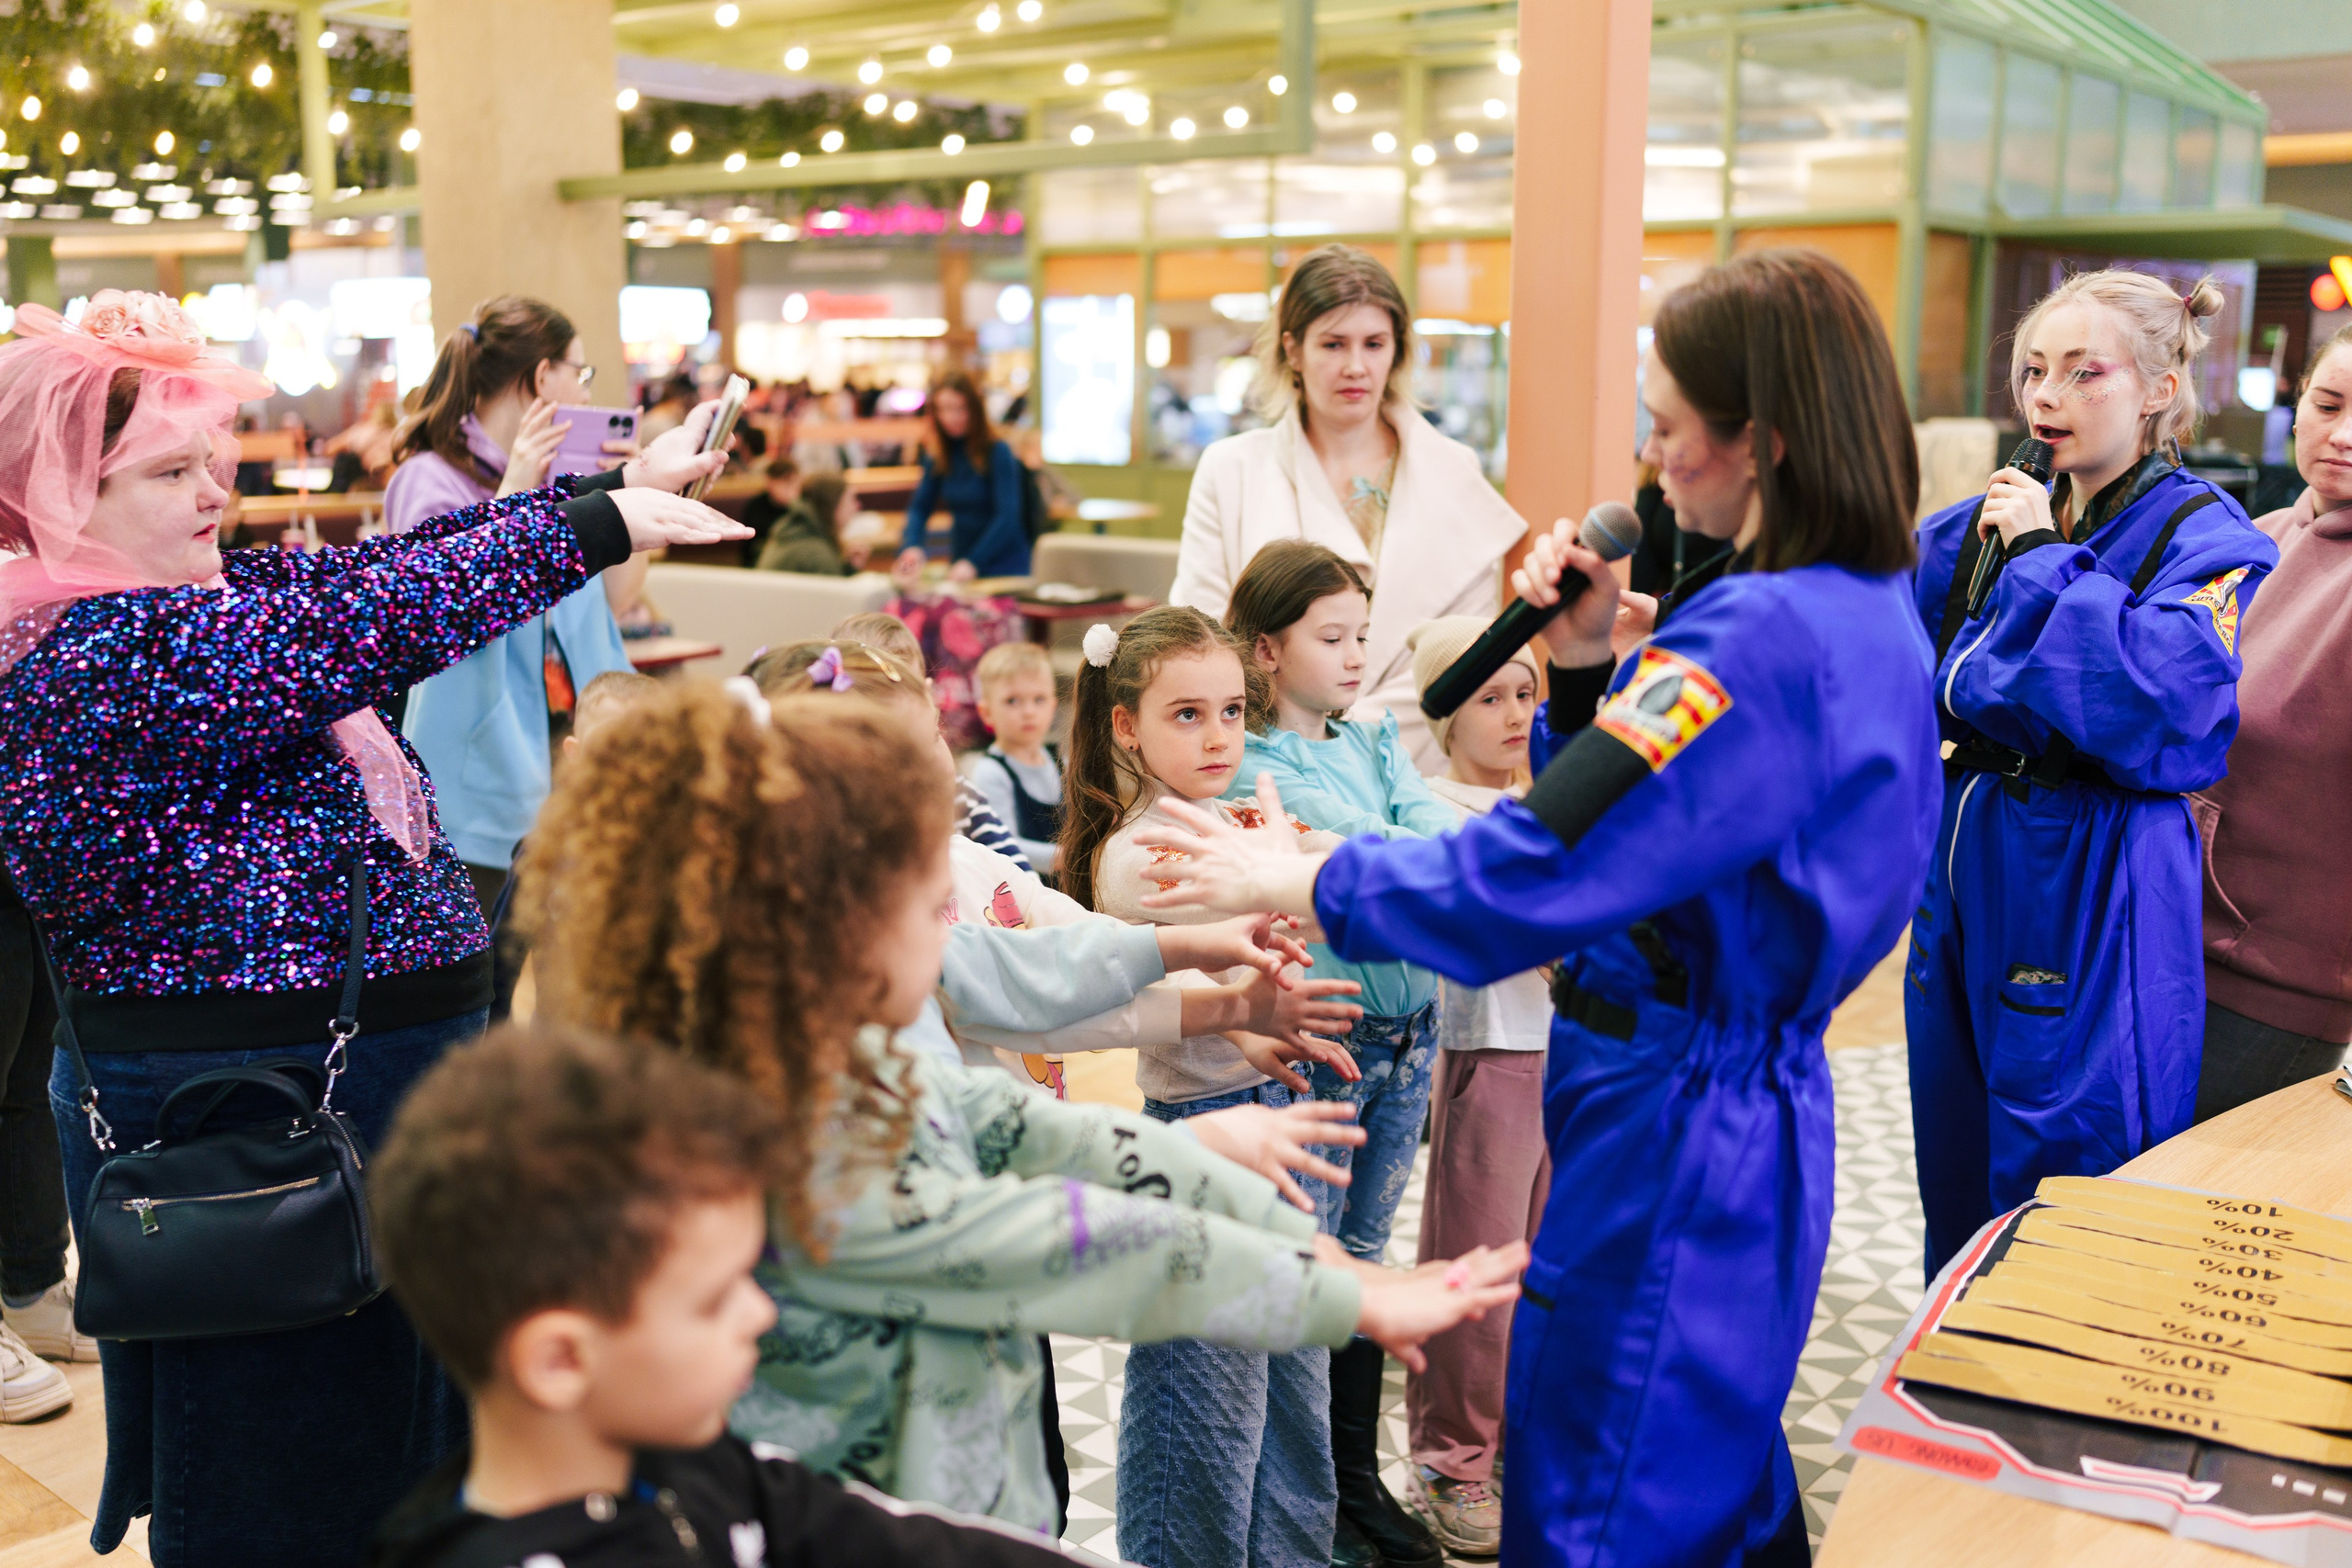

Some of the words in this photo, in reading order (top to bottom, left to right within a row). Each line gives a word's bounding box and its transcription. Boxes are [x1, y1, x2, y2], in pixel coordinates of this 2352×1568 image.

[2207, 1199, 2283, 1217] 10%
[2213, 1220, 2295, 1241] 20%
[2202, 1237, 2283, 1260] 30%
[2199, 1258, 2284, 1280] 40%
[2193, 1281, 2278, 1306] 50%
[2180, 1302, 2267, 1327] 60%
[2161, 1322, 2248, 1351] 70%
[2140, 1347, 2230, 1376] 80%
[2121, 1374, 2215, 1401] 90%
[2107, 1397, 2228, 1431] 100%
